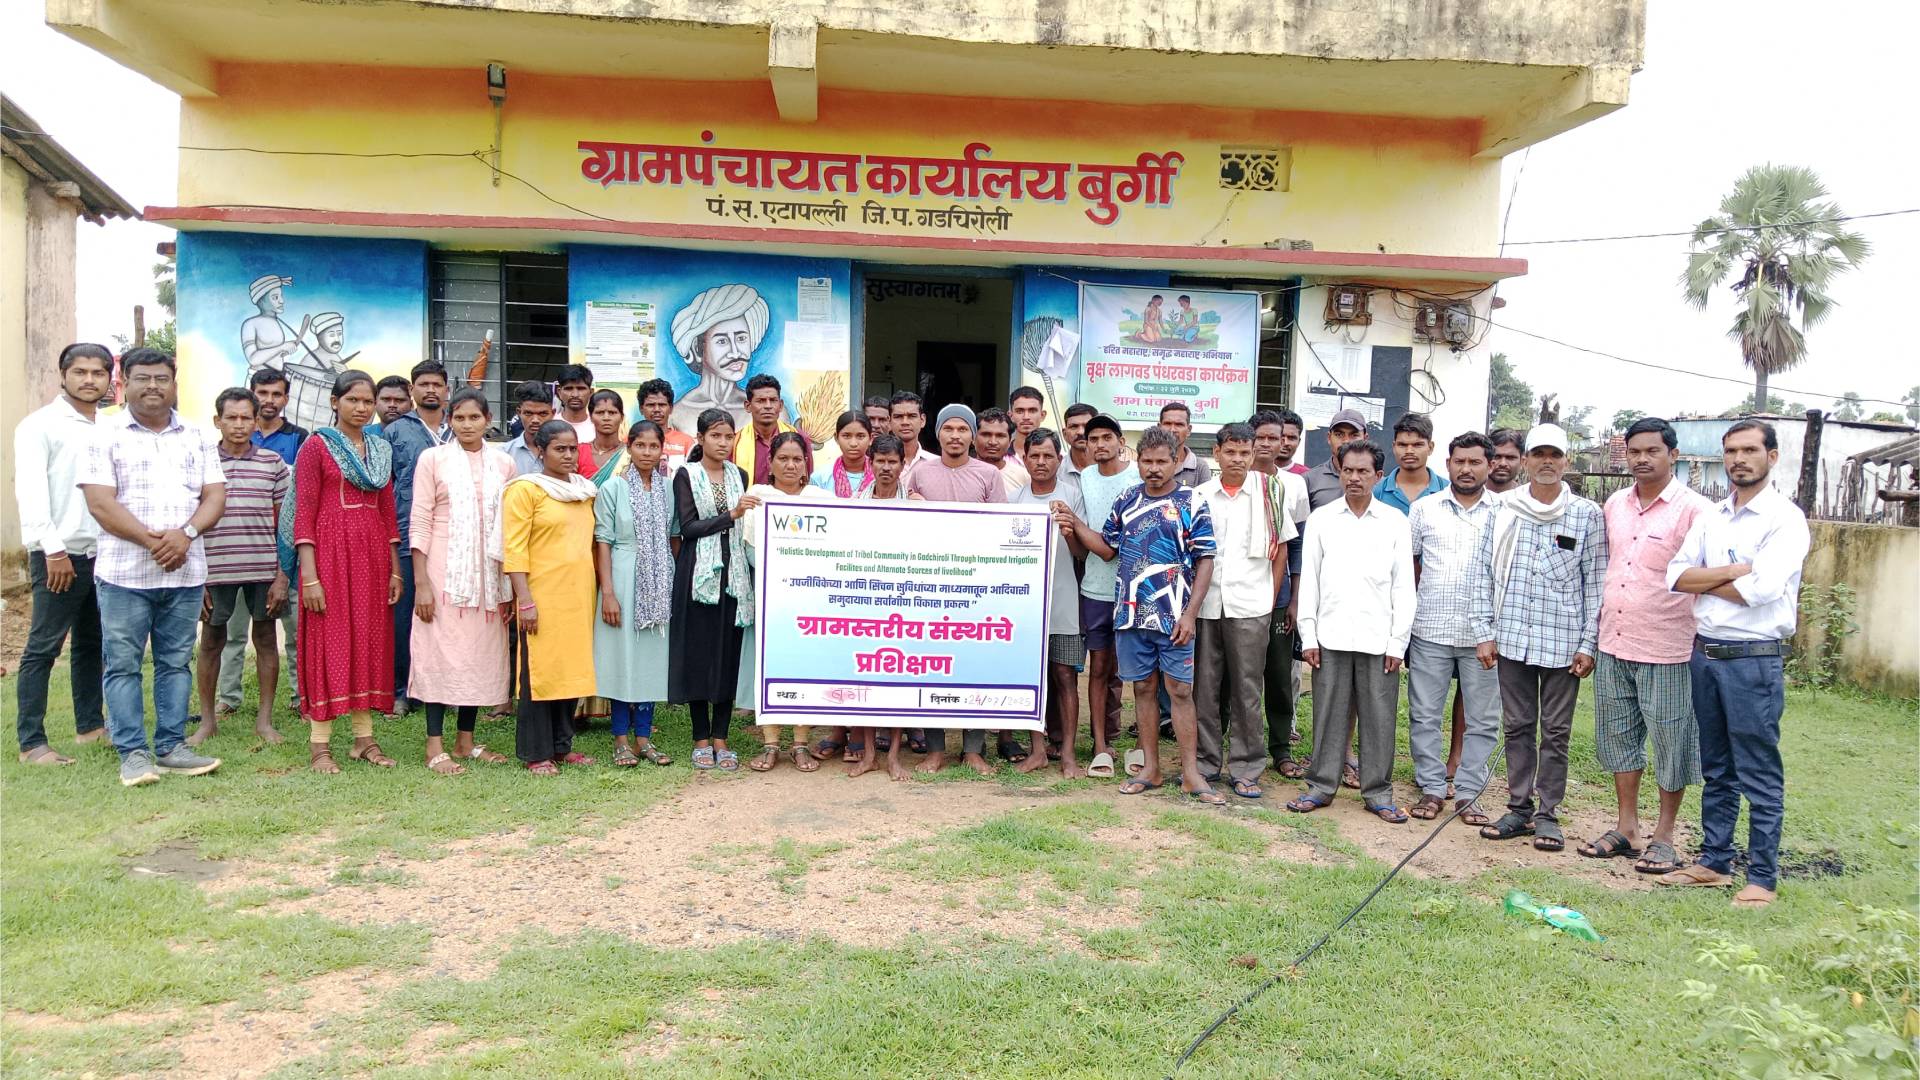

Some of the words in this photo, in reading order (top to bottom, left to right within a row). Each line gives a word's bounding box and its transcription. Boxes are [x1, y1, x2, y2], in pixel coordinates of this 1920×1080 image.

[578, 130, 861, 194] ग्रामपंचायत
[866, 142, 1071, 201] कार्यालय
[1077, 150, 1184, 226] बुर्गी
[1086, 362, 1107, 383] वृक्ष
[1108, 363, 1151, 379] लागवड
[1152, 361, 1198, 381] पंधरवडा
[772, 513, 828, 533] WOTR
[805, 548, 846, 561] Development
[847, 550, 854, 558] of
[873, 550, 908, 562] Community
[909, 551, 917, 561] in
[951, 553, 976, 564] Through
[977, 554, 1007, 566] Improved
[1008, 555, 1038, 565] Irrigation
[864, 563, 876, 571] and
[907, 565, 933, 575] Sources
[933, 566, 941, 575] of
[844, 578, 867, 591] आणि
[990, 583, 1030, 596] आदिवासी
[913, 595, 942, 609] विकास
[943, 598, 970, 610] प्रकल्प
[796, 613, 925, 640] ग्रामस्तरीय
[928, 615, 1014, 642] संस्थांचे
[855, 647, 953, 675] प्रशिक्षण
